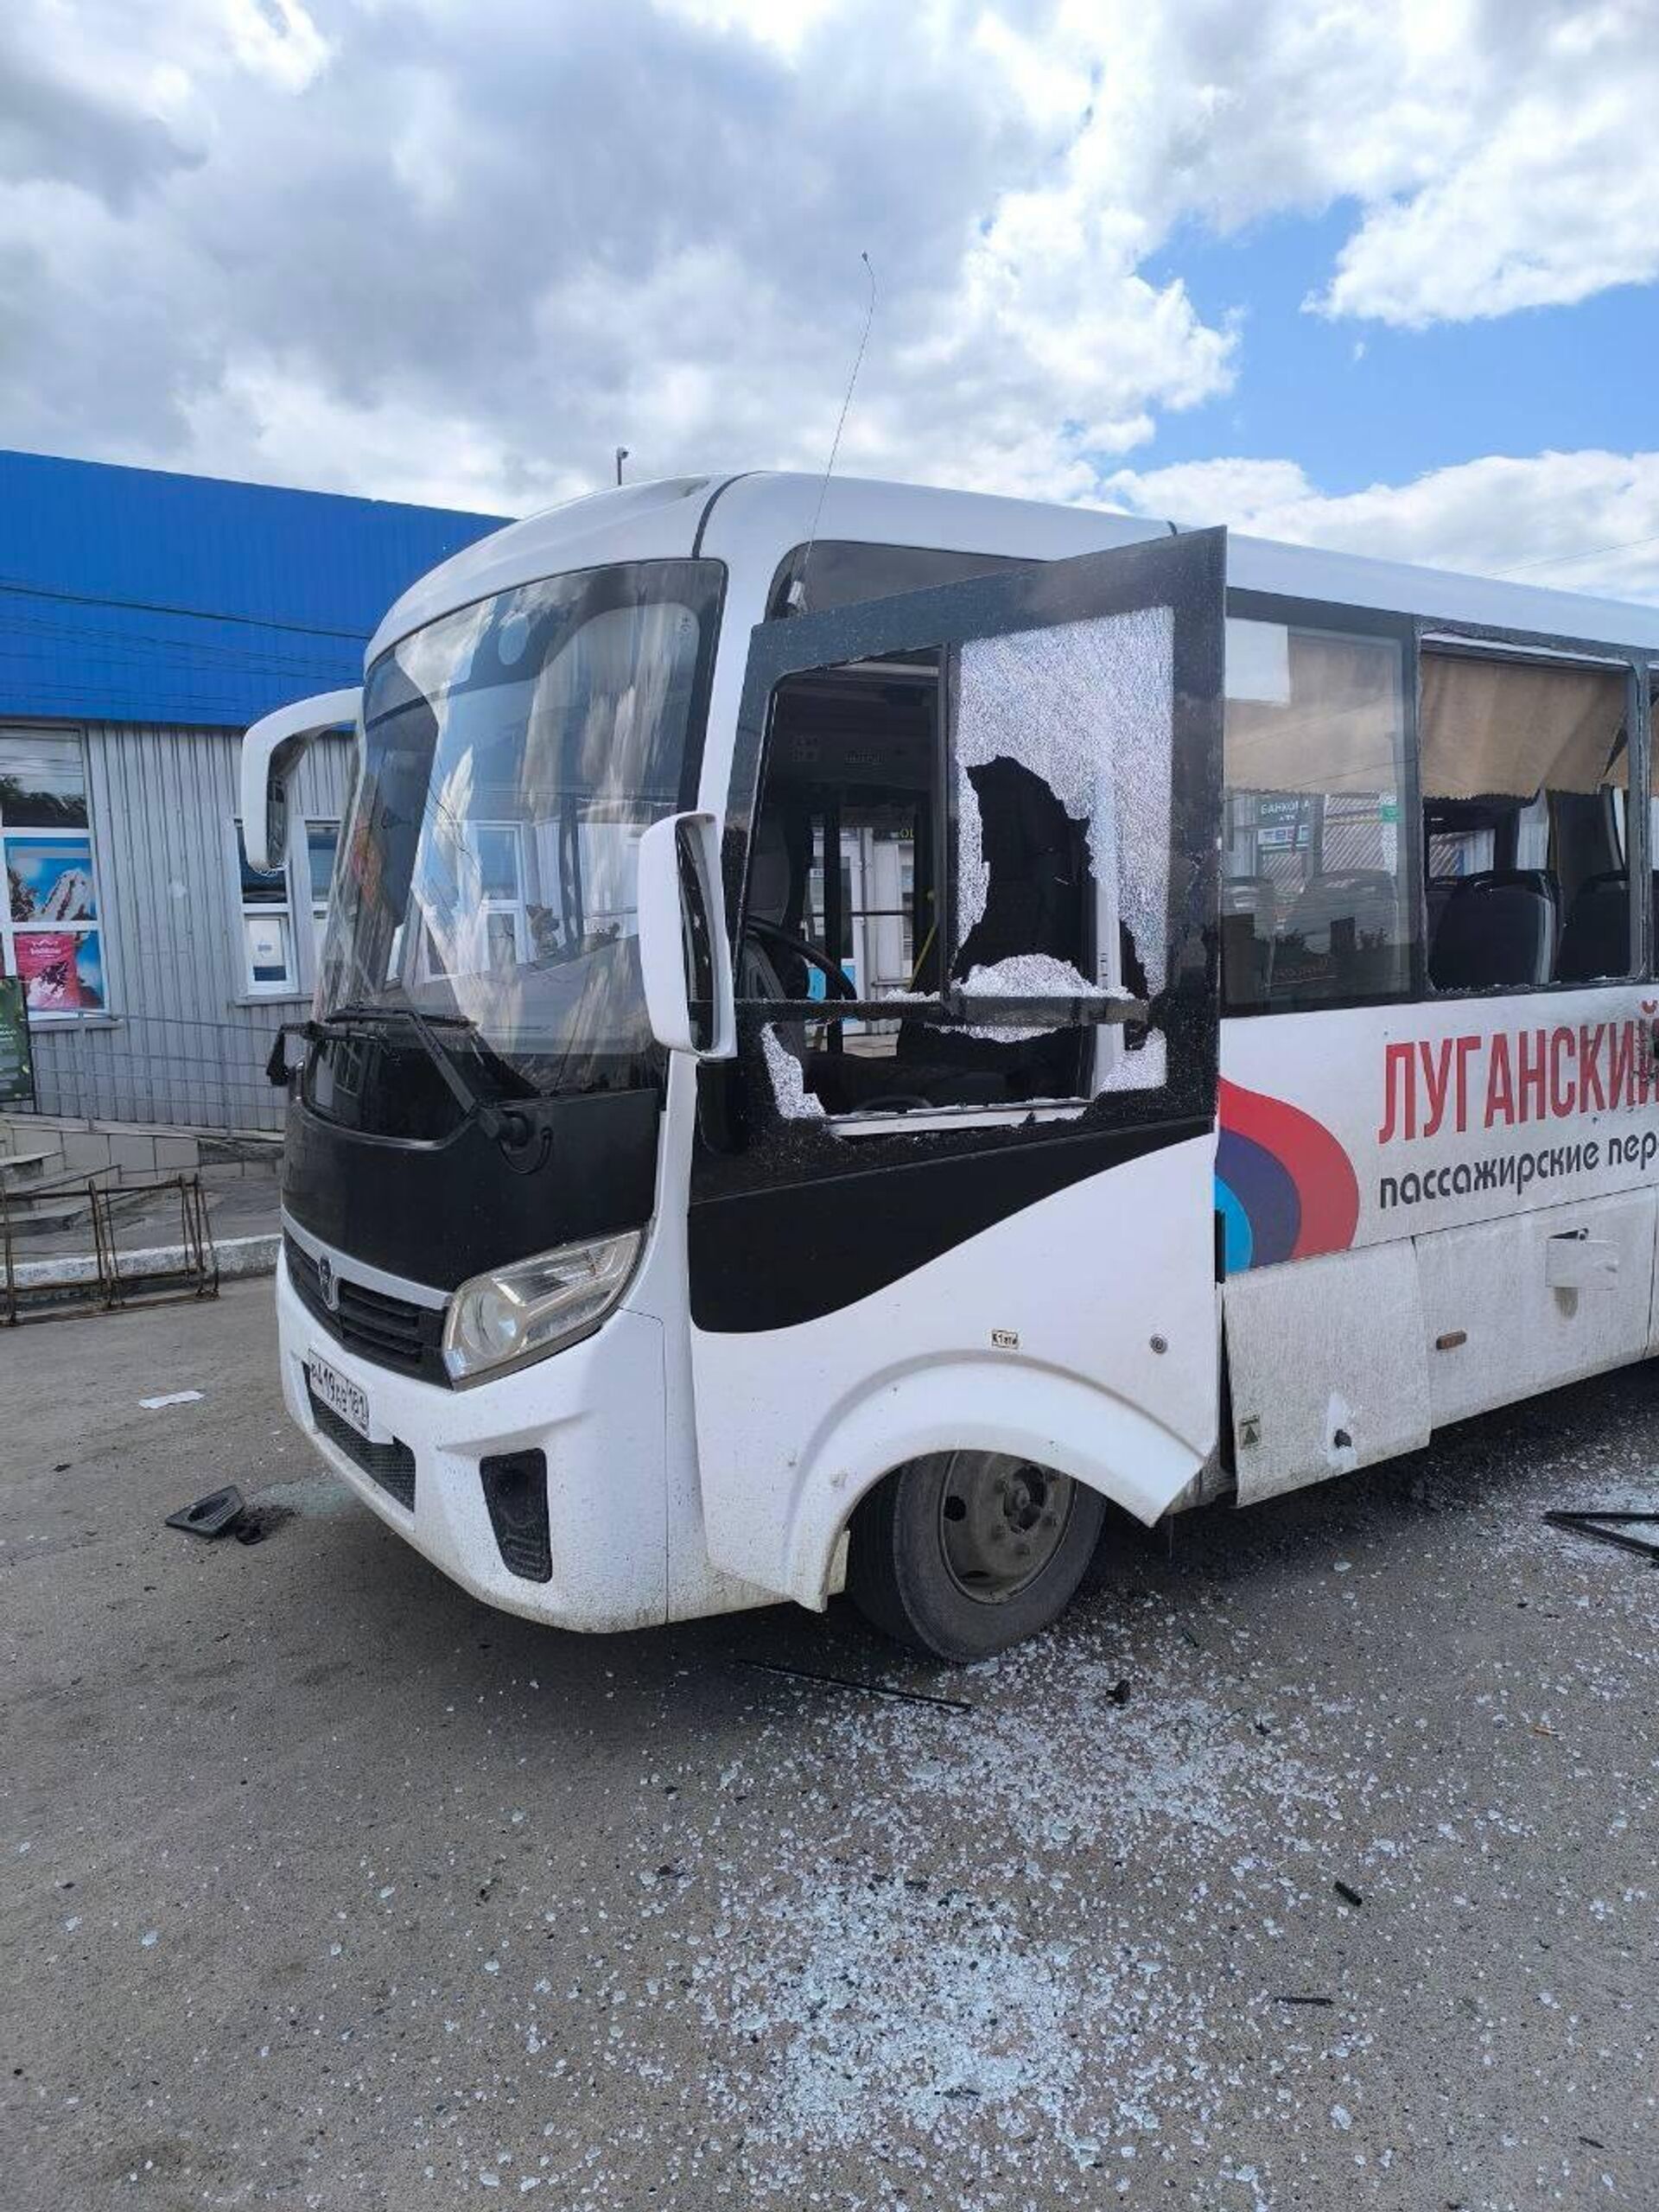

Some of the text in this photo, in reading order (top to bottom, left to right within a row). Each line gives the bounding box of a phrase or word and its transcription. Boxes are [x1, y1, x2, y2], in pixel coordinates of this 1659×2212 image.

[1378, 1000, 1659, 1145] ЛУГАНСКИЙ
[1380, 1130, 1658, 1210] пассажирские пер
